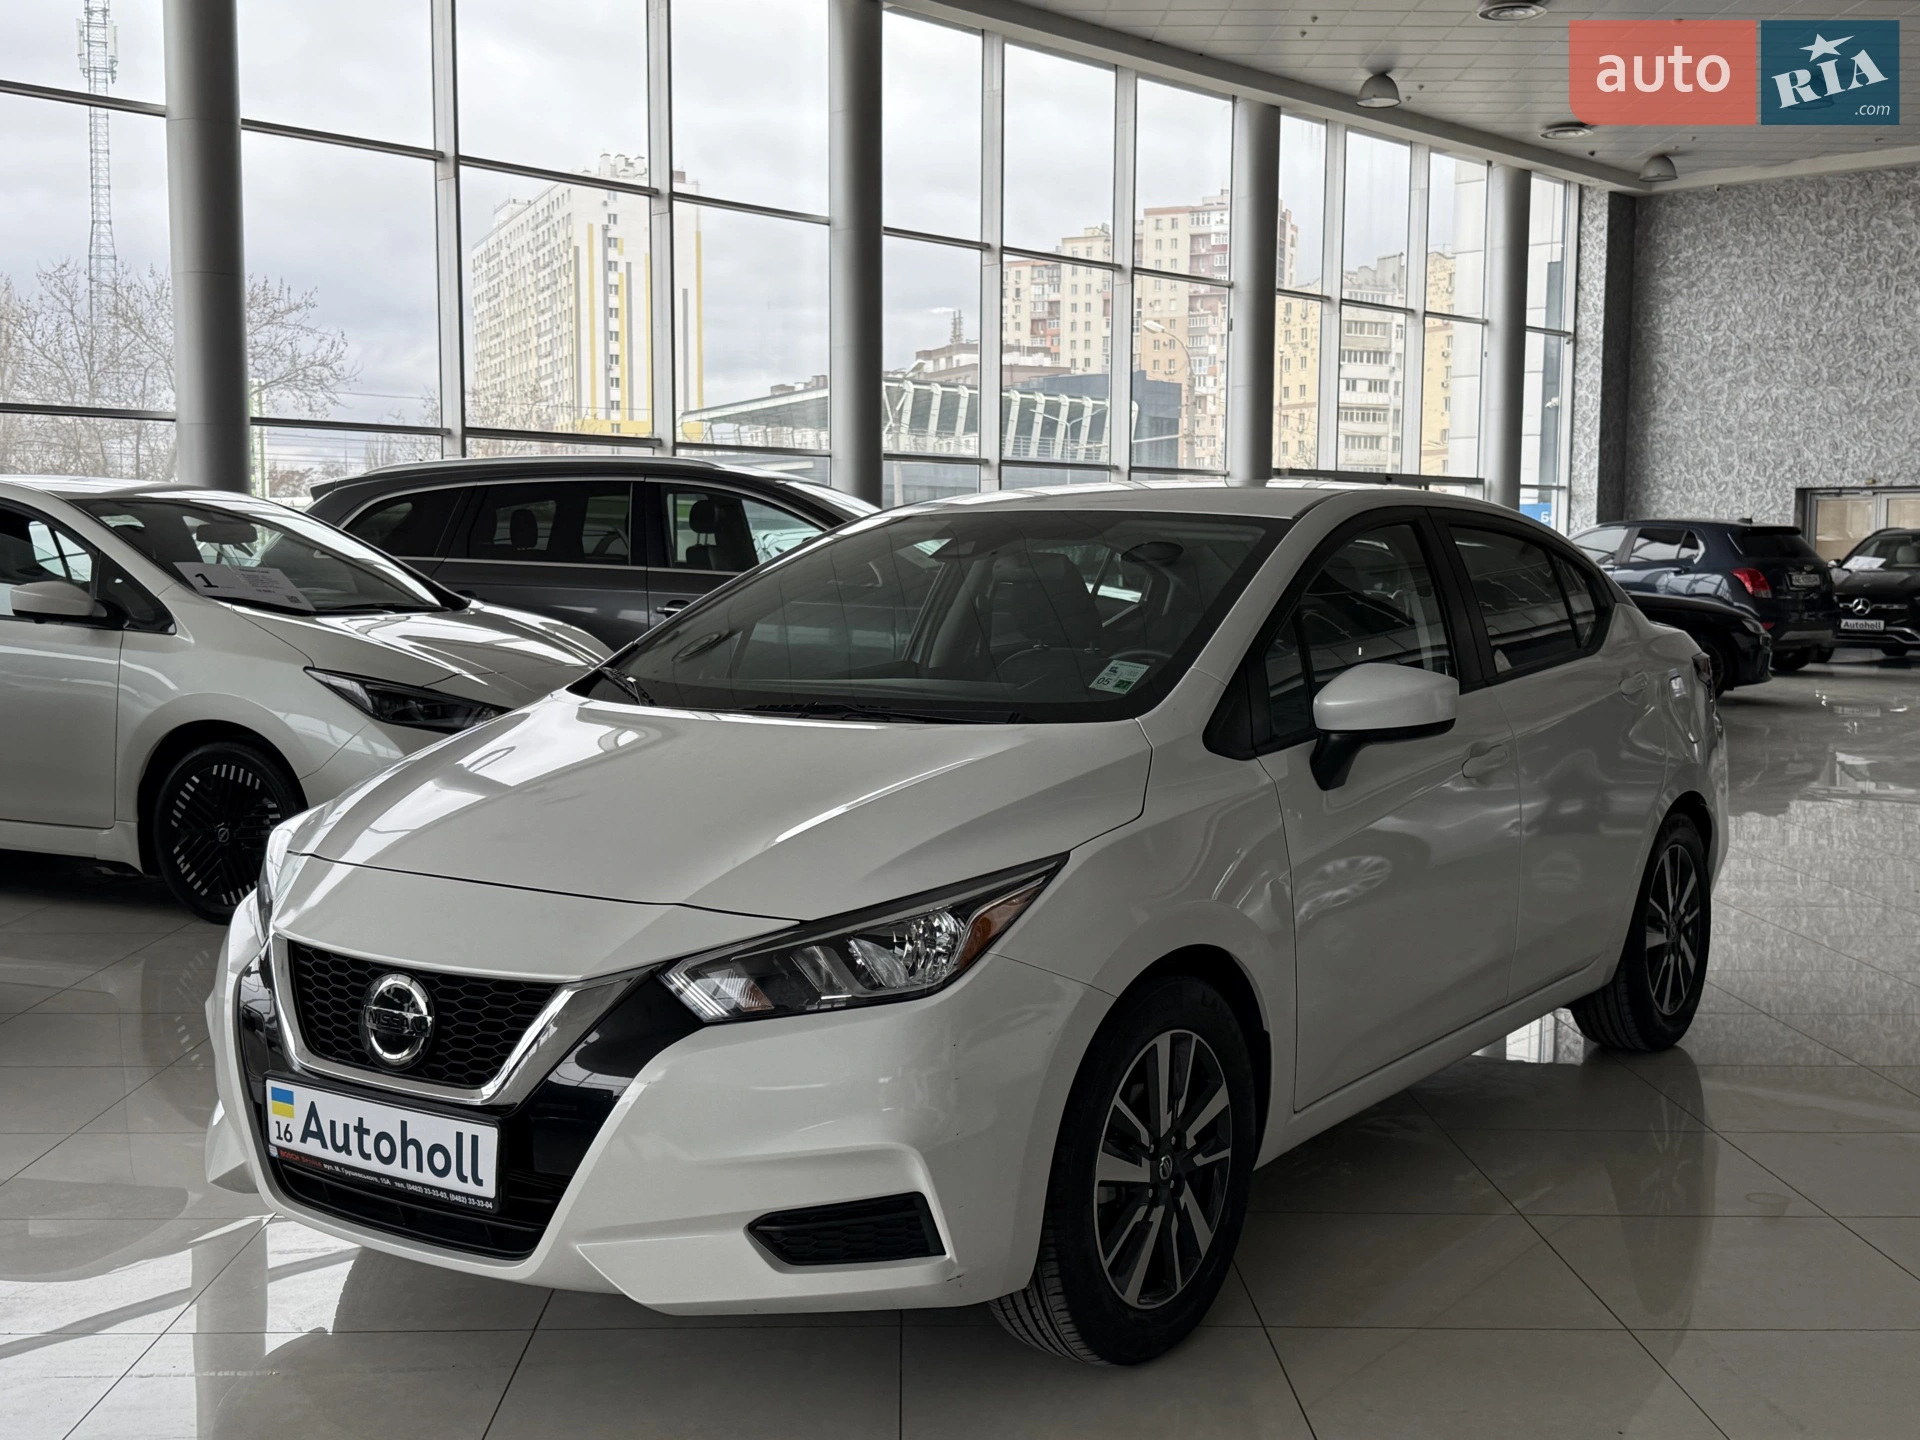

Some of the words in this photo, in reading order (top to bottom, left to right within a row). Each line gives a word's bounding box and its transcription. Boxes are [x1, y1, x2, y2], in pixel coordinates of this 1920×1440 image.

[195, 573, 219, 588] 1
[1843, 621, 1881, 630] Autoholl
[1096, 677, 1112, 686] 05
[1115, 680, 1132, 689] 27
[367, 1007, 424, 1033] NISSAN
[275, 1121, 293, 1143] 16
[300, 1100, 484, 1187] Autoholl
